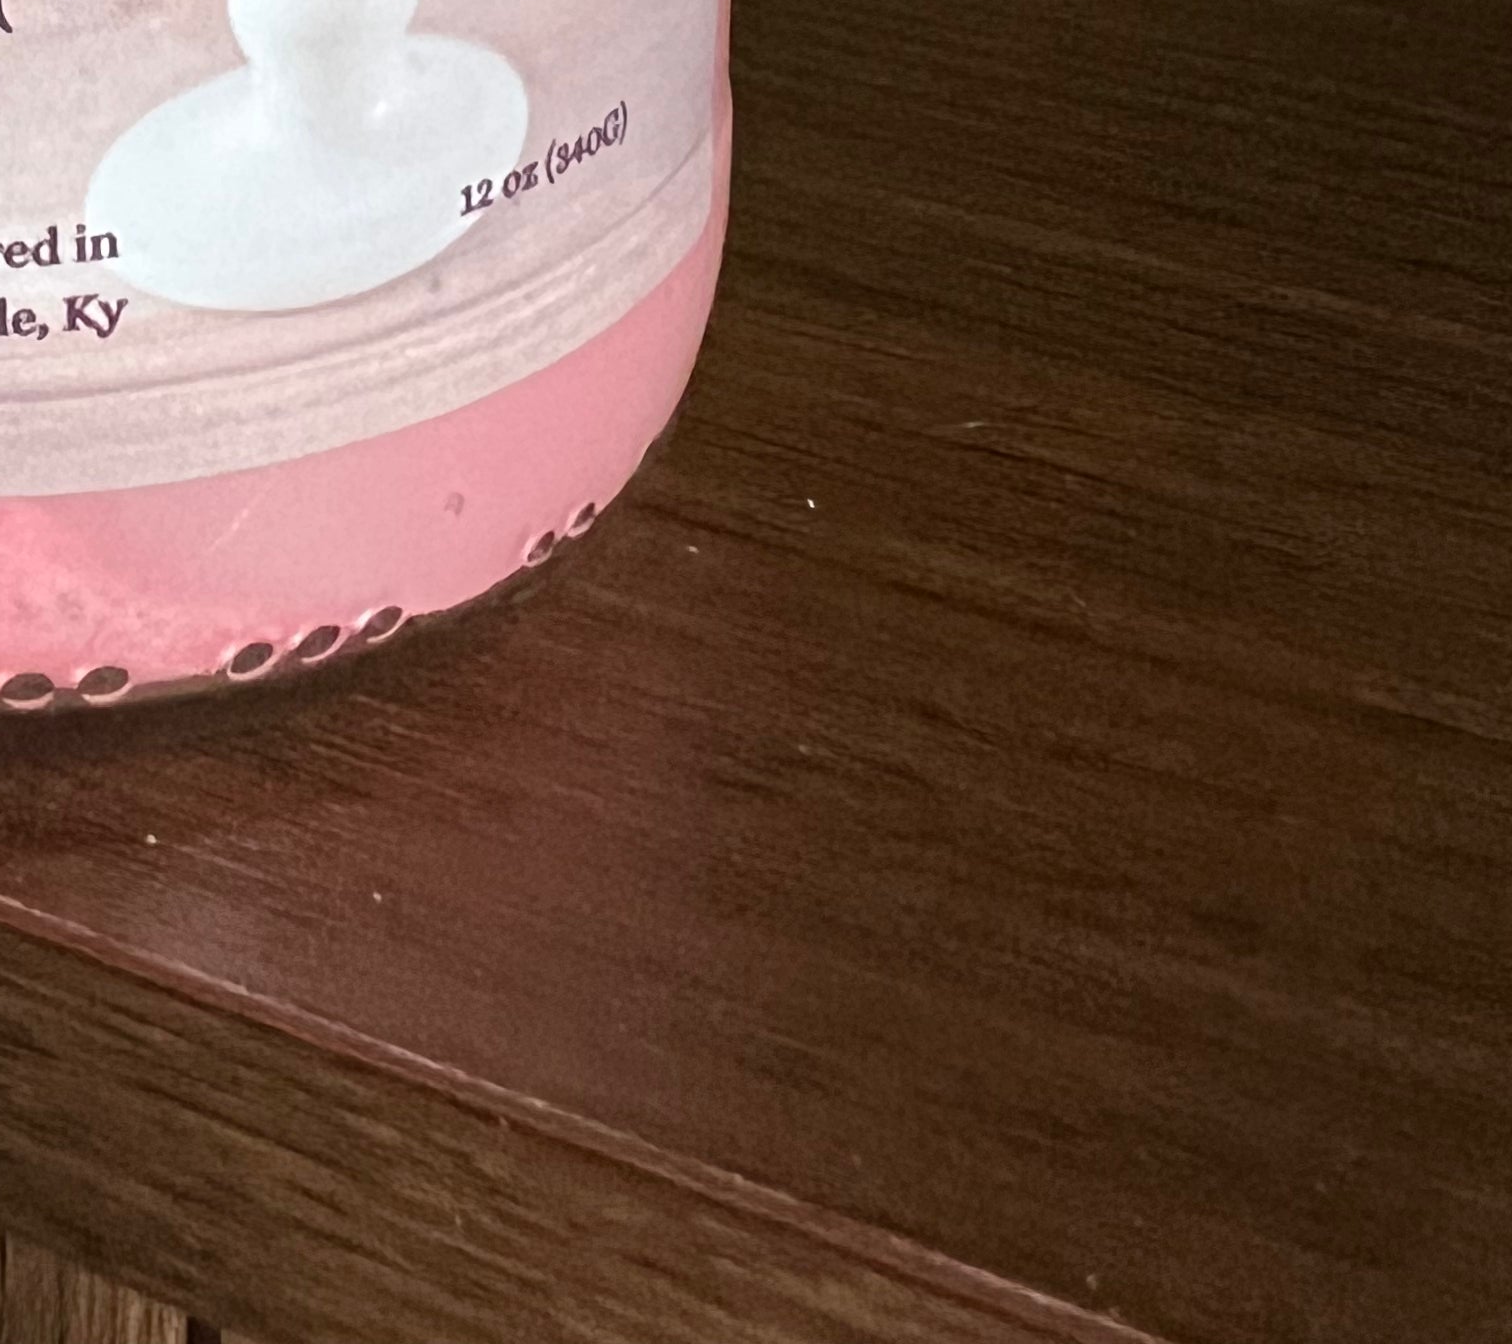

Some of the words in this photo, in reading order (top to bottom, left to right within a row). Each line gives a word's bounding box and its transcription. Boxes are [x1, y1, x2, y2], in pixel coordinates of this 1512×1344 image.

[460, 179, 493, 216] 12
[502, 161, 539, 198] oz
[74, 224, 119, 263] in
[62, 294, 128, 339] Ky
